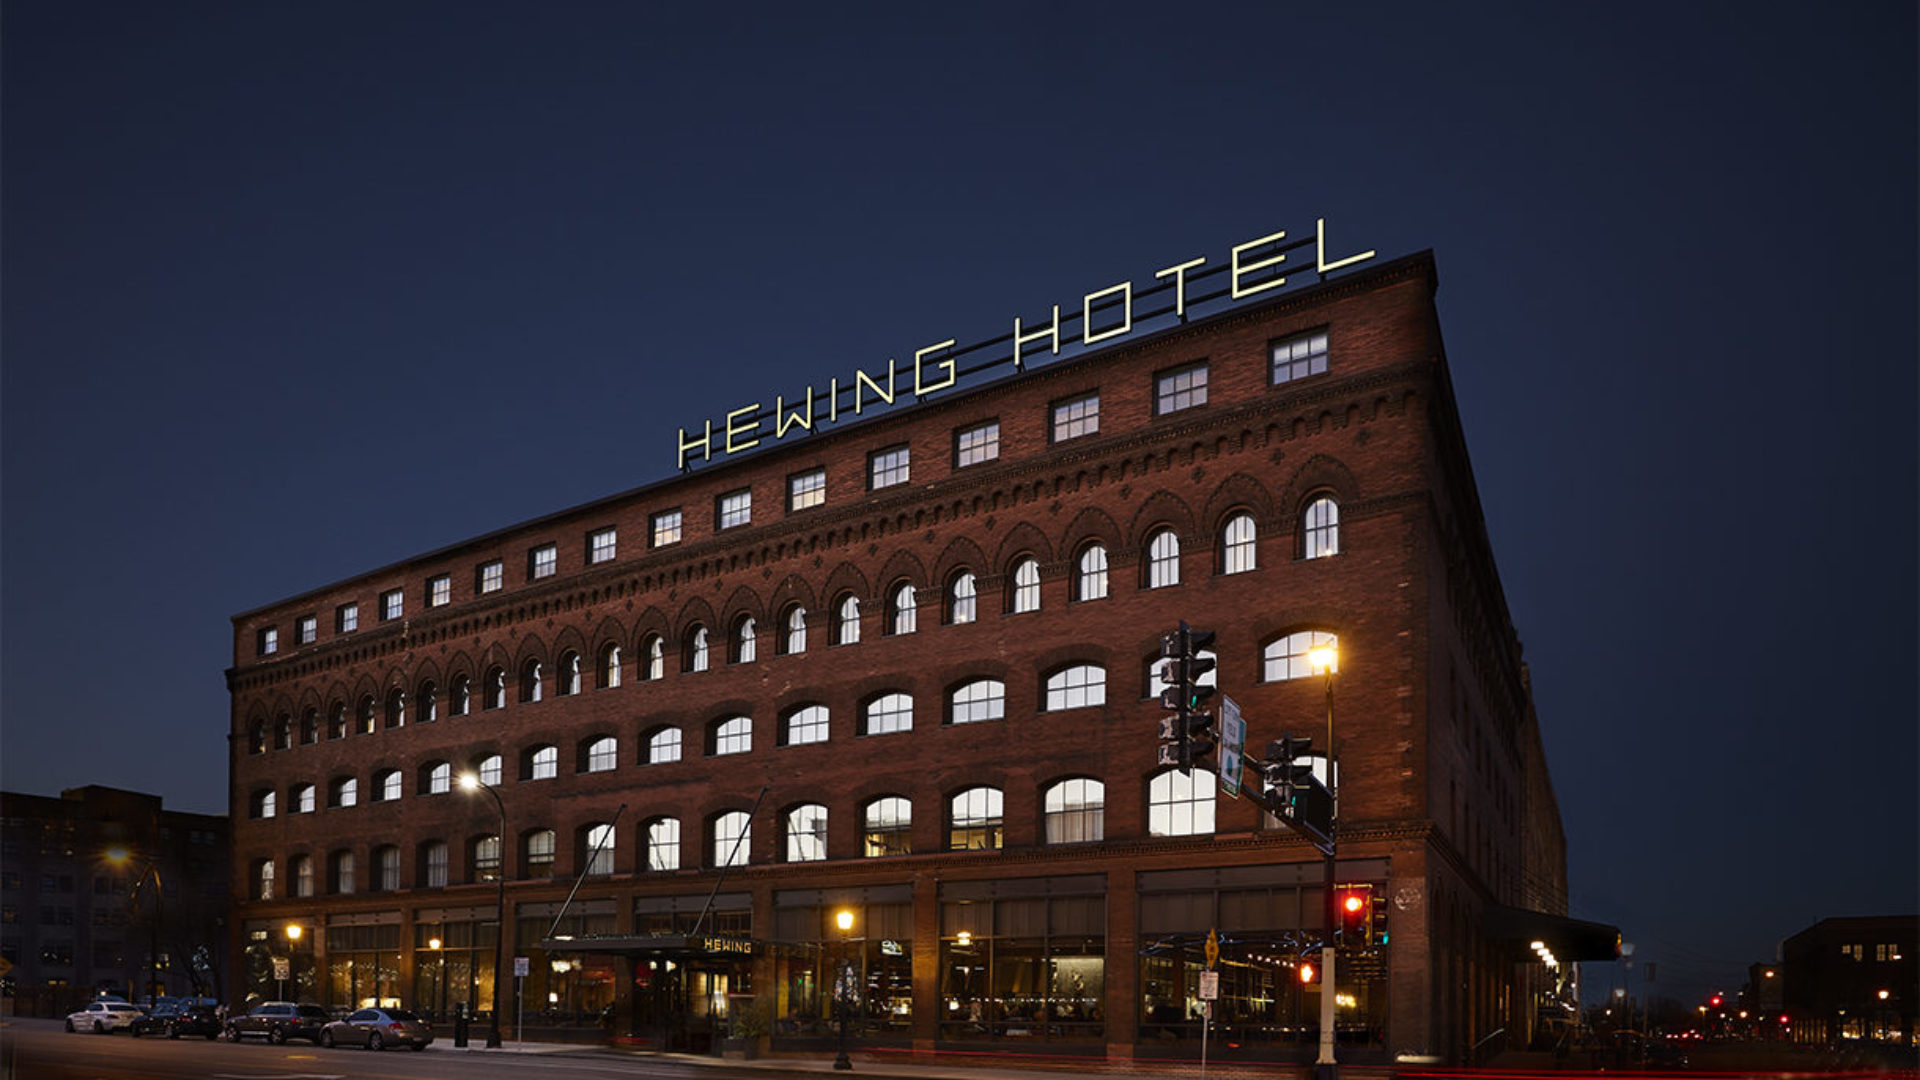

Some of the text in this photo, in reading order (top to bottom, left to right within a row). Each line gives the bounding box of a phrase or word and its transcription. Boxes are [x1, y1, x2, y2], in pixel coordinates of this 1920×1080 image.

[678, 218, 1376, 469] HEWING HOTEL
[704, 937, 751, 954] HEWING
